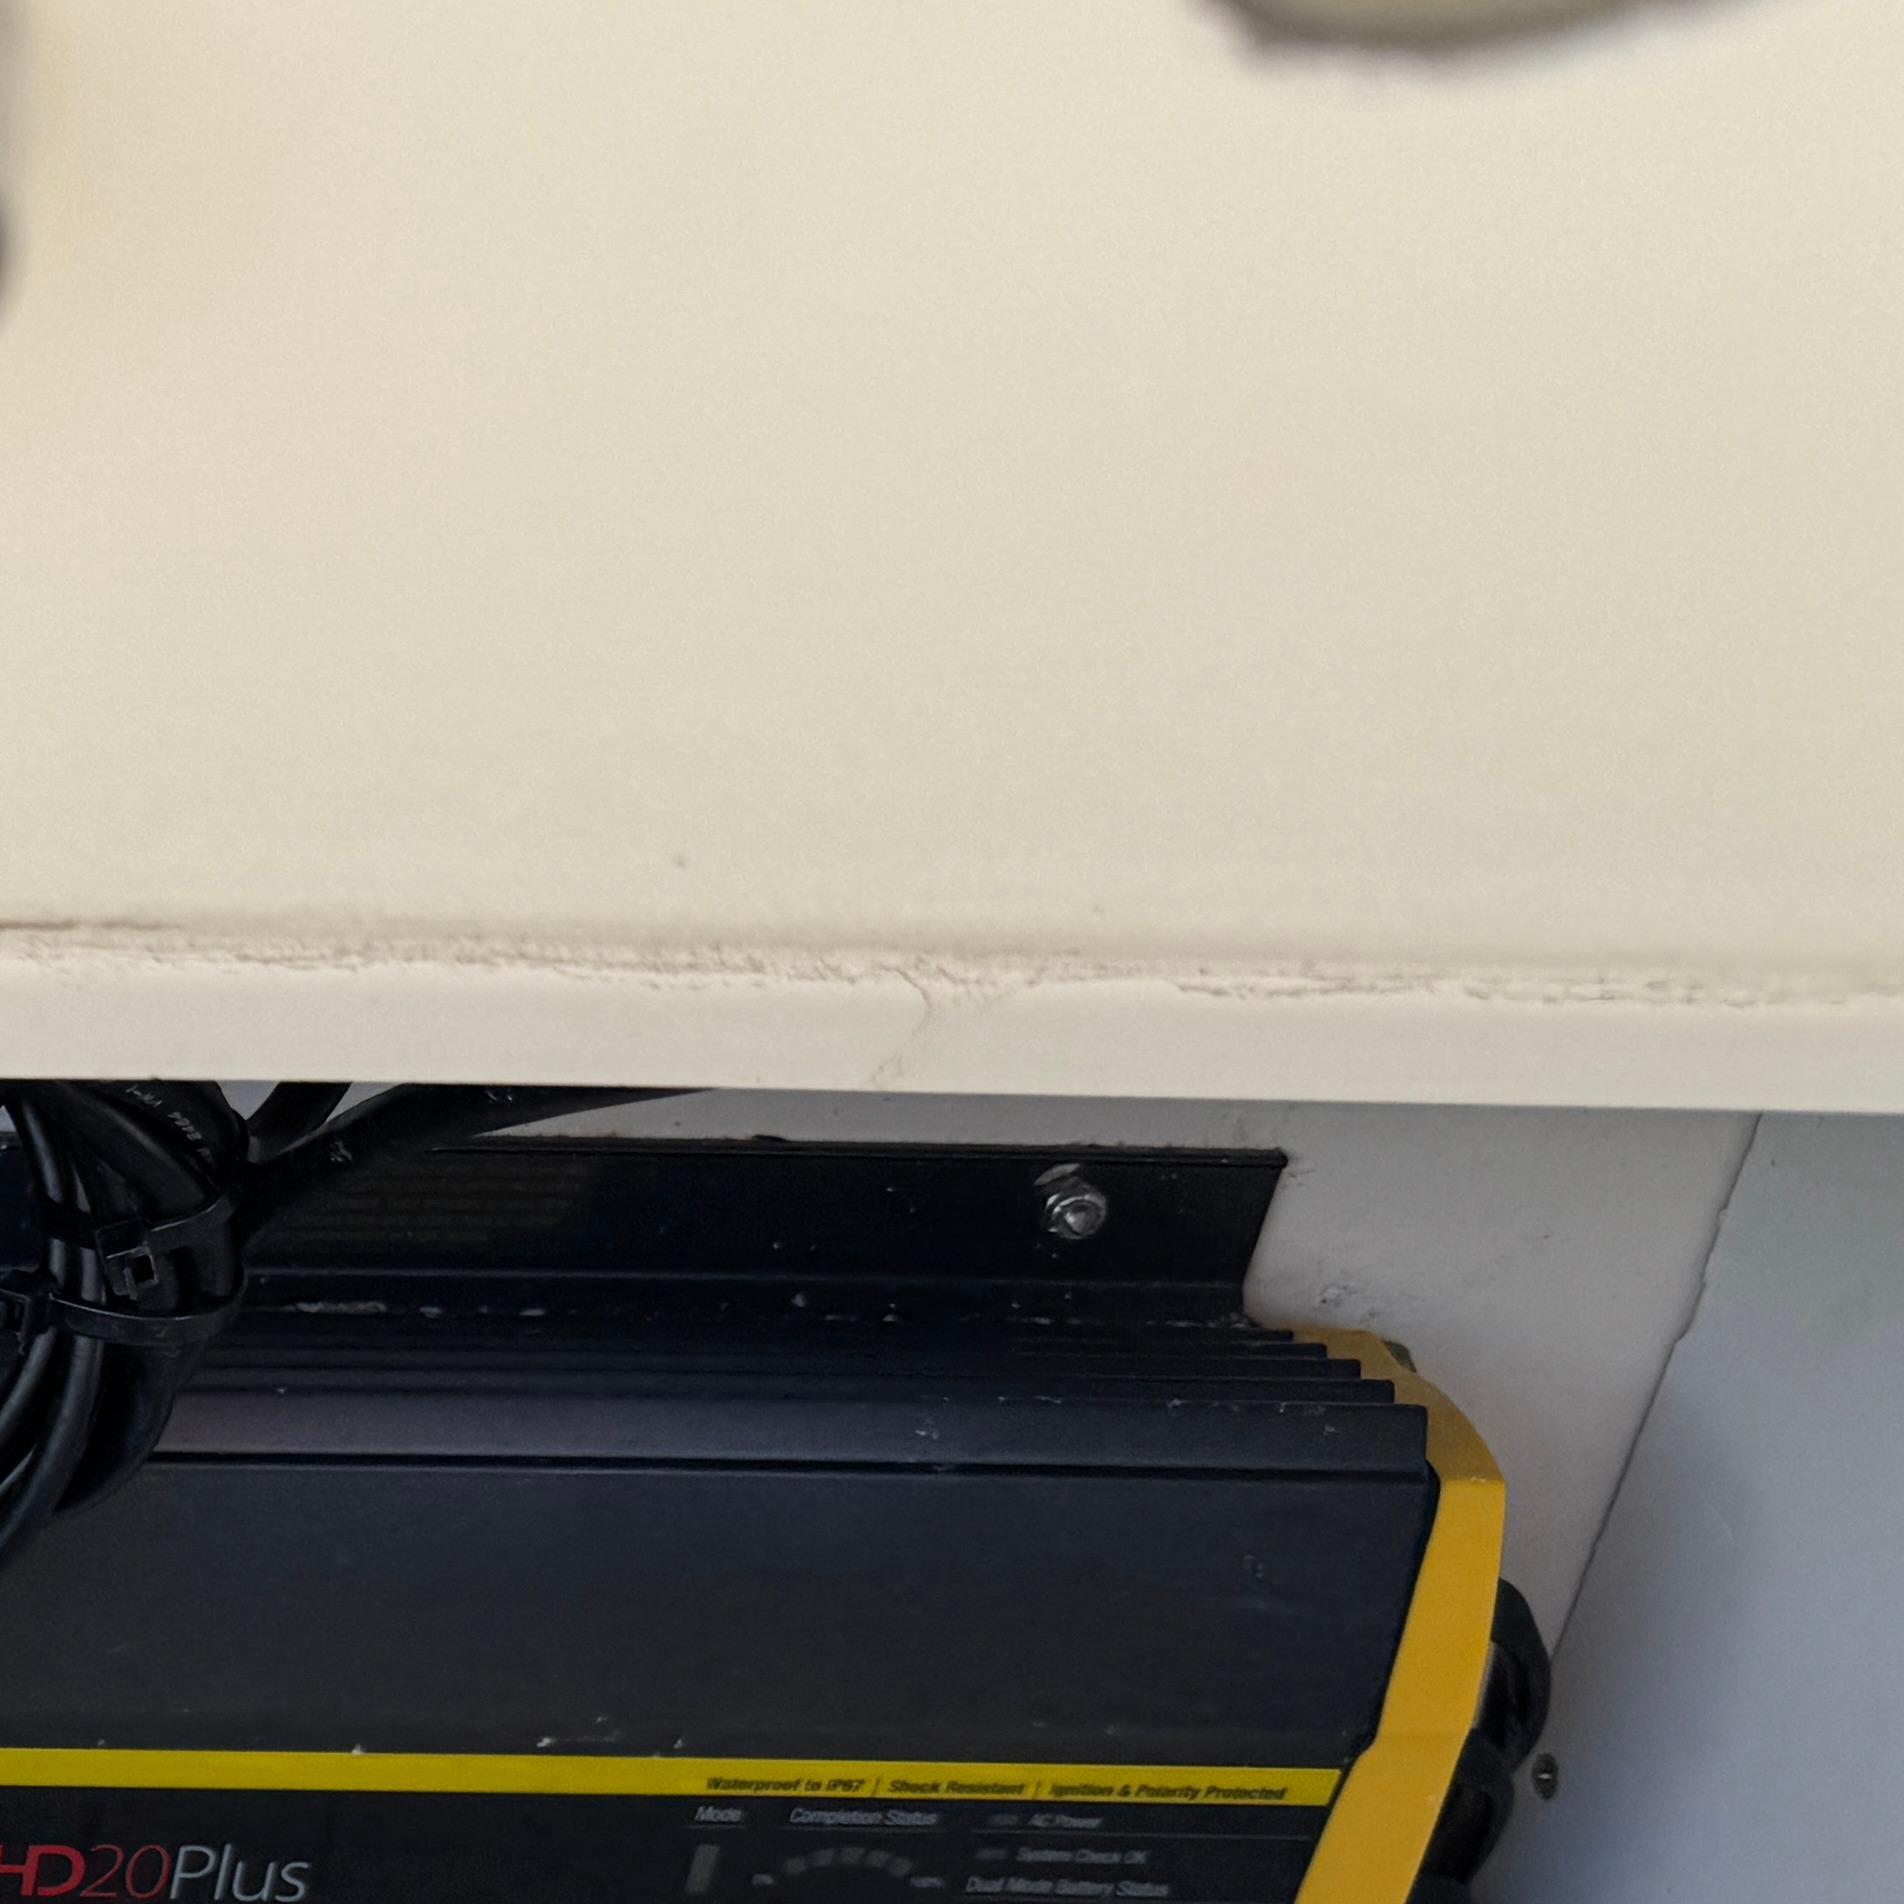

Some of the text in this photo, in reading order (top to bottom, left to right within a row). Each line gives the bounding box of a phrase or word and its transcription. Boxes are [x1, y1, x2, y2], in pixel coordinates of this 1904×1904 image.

[707, 1777, 802, 1791] Waterproof
[805, 1779, 822, 1791] to
[888, 1780, 941, 1793] Shock
[1117, 1785, 1131, 1797] &
[1204, 1786, 1288, 1801] Protected
[694, 1805, 743, 1822] Mode
[789, 1807, 883, 1825] Completion
[884, 1809, 938, 1826] Status
